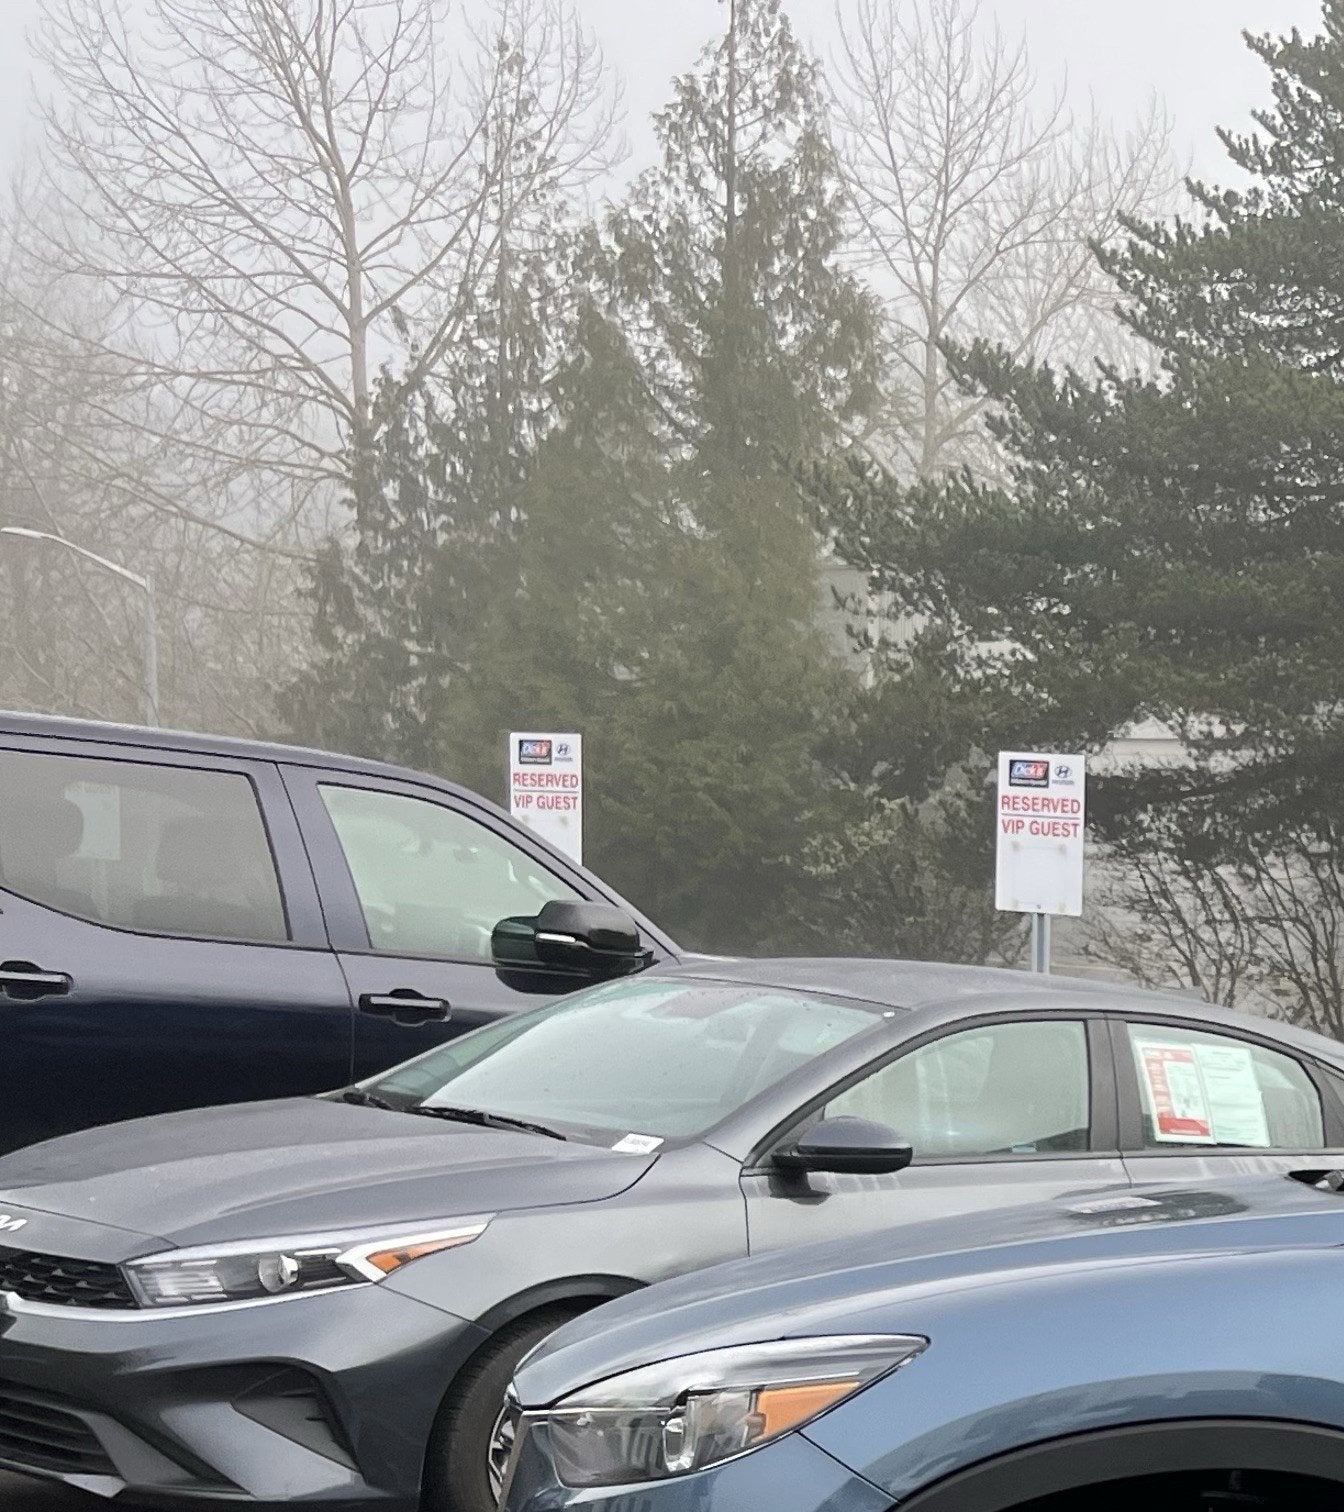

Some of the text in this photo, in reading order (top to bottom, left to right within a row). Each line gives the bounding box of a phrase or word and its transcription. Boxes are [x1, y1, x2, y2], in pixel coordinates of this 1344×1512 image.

[512, 772, 579, 788] RESERVED
[514, 795, 579, 810] VIP GUEST
[1001, 795, 1081, 814] RESERVED
[1002, 819, 1080, 838] VIP GUEST
